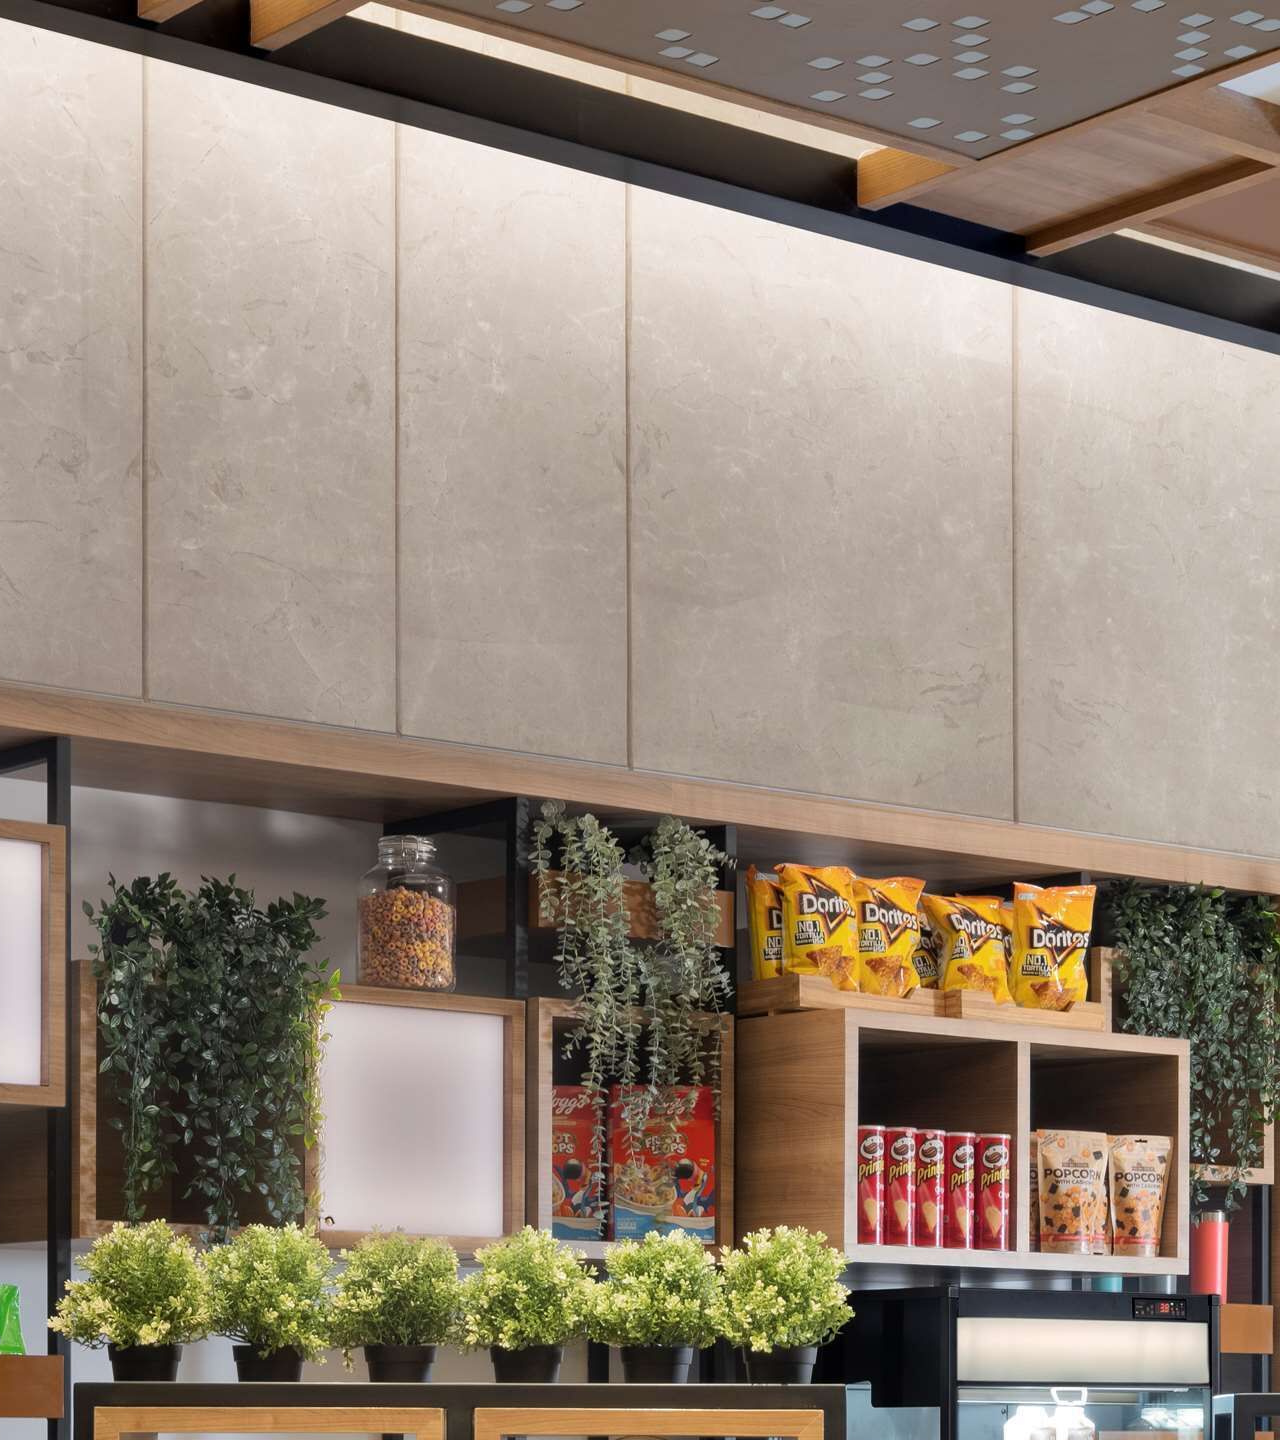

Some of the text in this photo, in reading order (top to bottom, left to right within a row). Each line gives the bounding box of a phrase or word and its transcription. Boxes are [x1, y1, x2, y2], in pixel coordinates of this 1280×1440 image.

[865, 903, 918, 931] Doritos
[950, 913, 1003, 941] Doritos
[1033, 928, 1089, 949] Doritos
[1044, 1168, 1101, 1181] POPCORN
